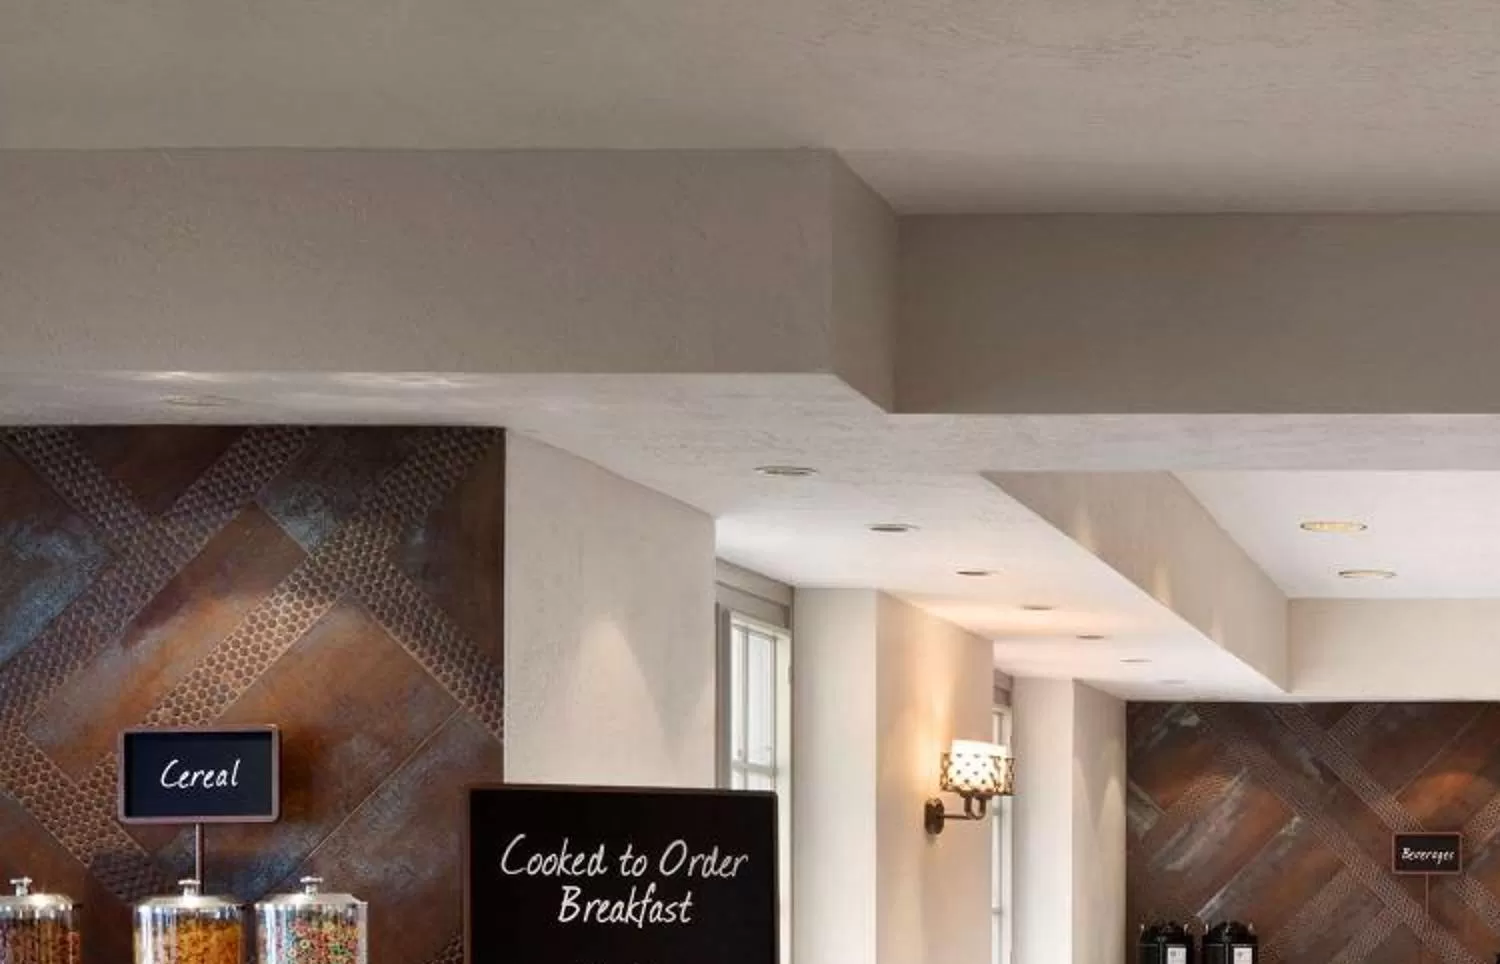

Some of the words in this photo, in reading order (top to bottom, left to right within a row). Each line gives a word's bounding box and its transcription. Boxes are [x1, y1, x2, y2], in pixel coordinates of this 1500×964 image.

[160, 758, 241, 789] Cereal
[500, 832, 608, 878] Cooked
[618, 843, 647, 878] to
[658, 839, 749, 880] Order
[1401, 847, 1455, 865] Beverages
[557, 881, 693, 929] Breakfast
